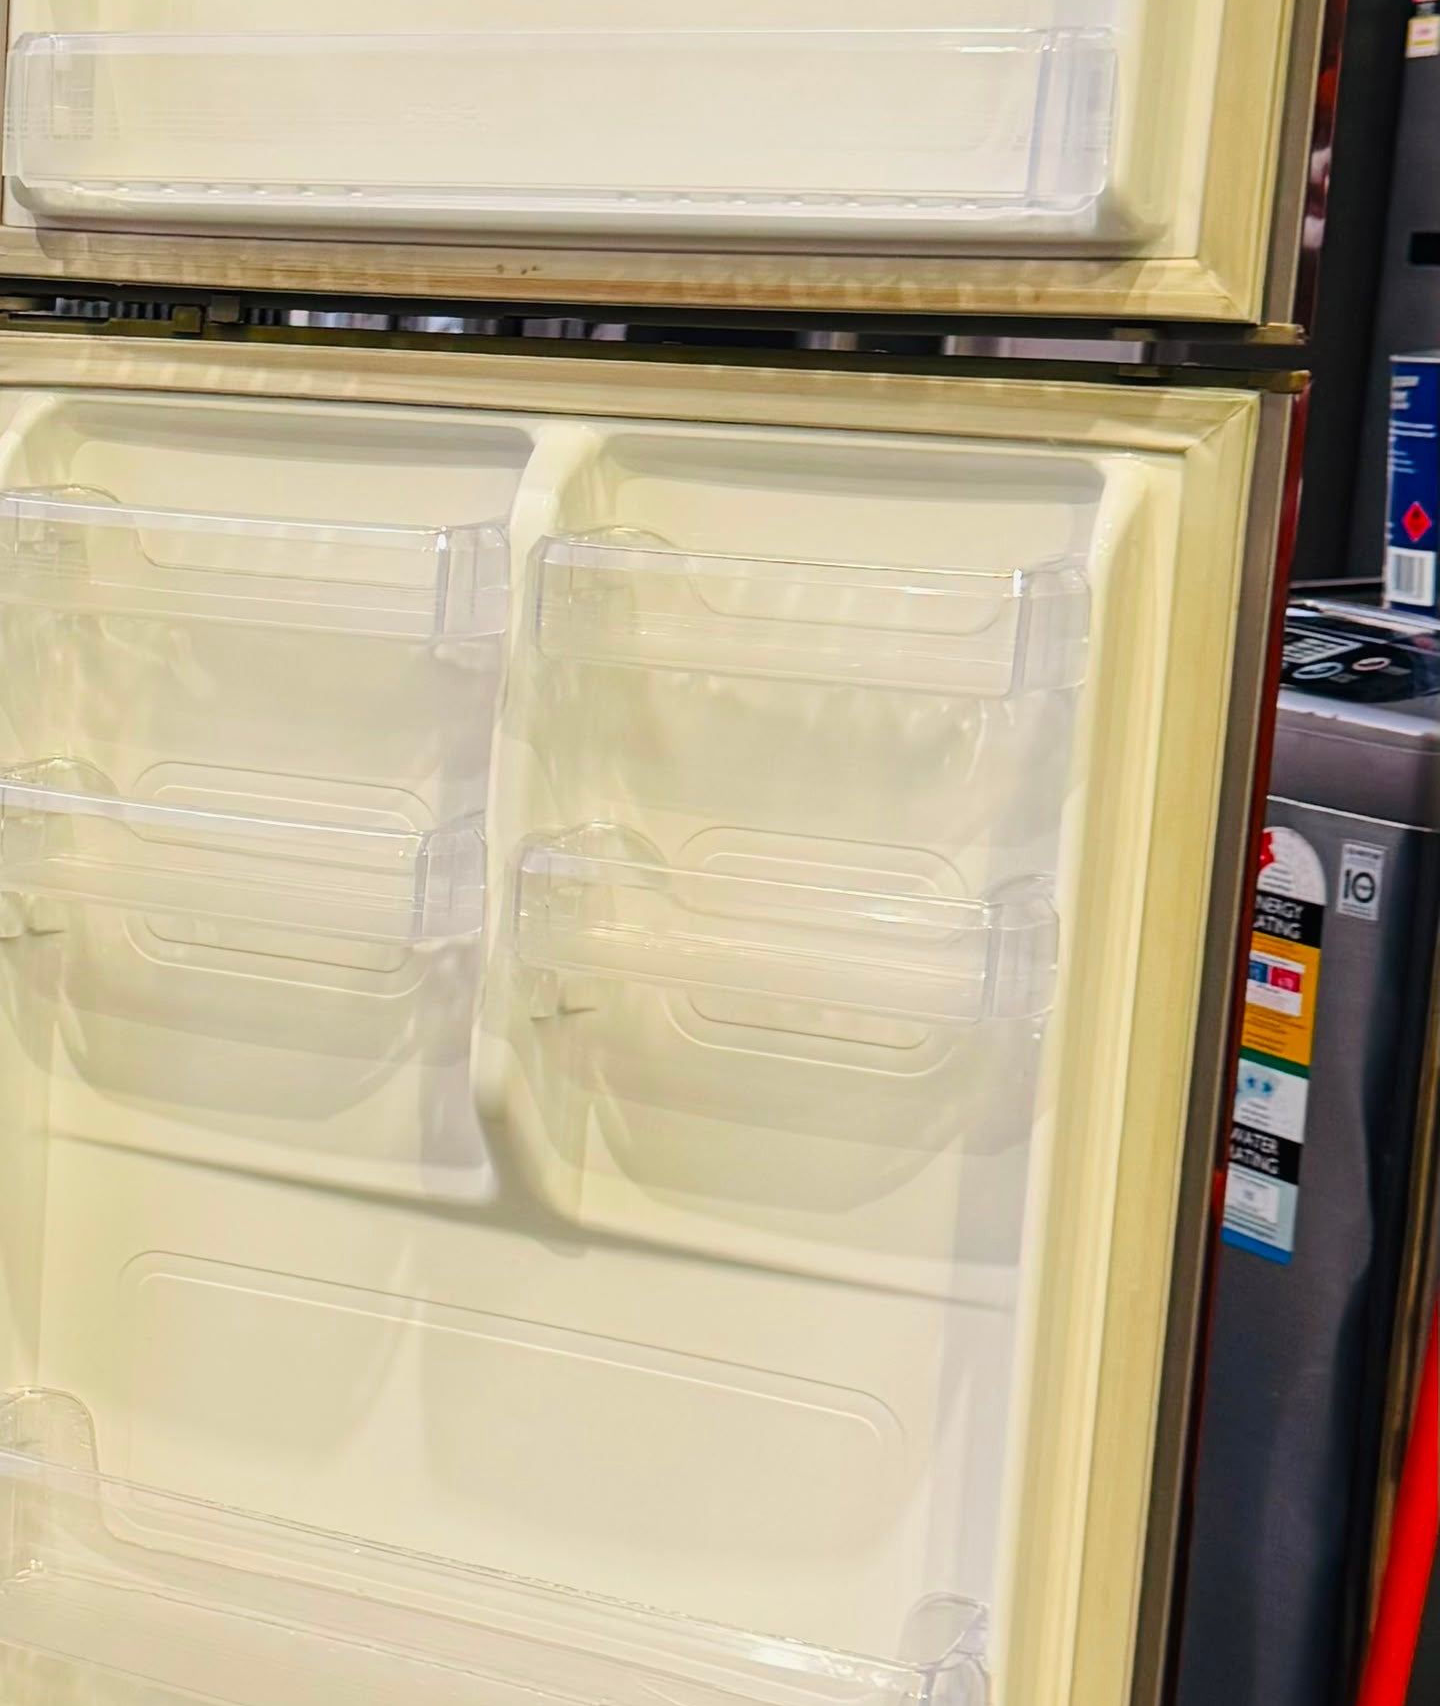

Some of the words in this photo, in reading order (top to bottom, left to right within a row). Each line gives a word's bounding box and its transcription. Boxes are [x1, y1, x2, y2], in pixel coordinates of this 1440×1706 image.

[1254, 894, 1304, 920] NERGY
[1252, 914, 1302, 940] ATING
[1229, 1143, 1280, 1175] ATING
